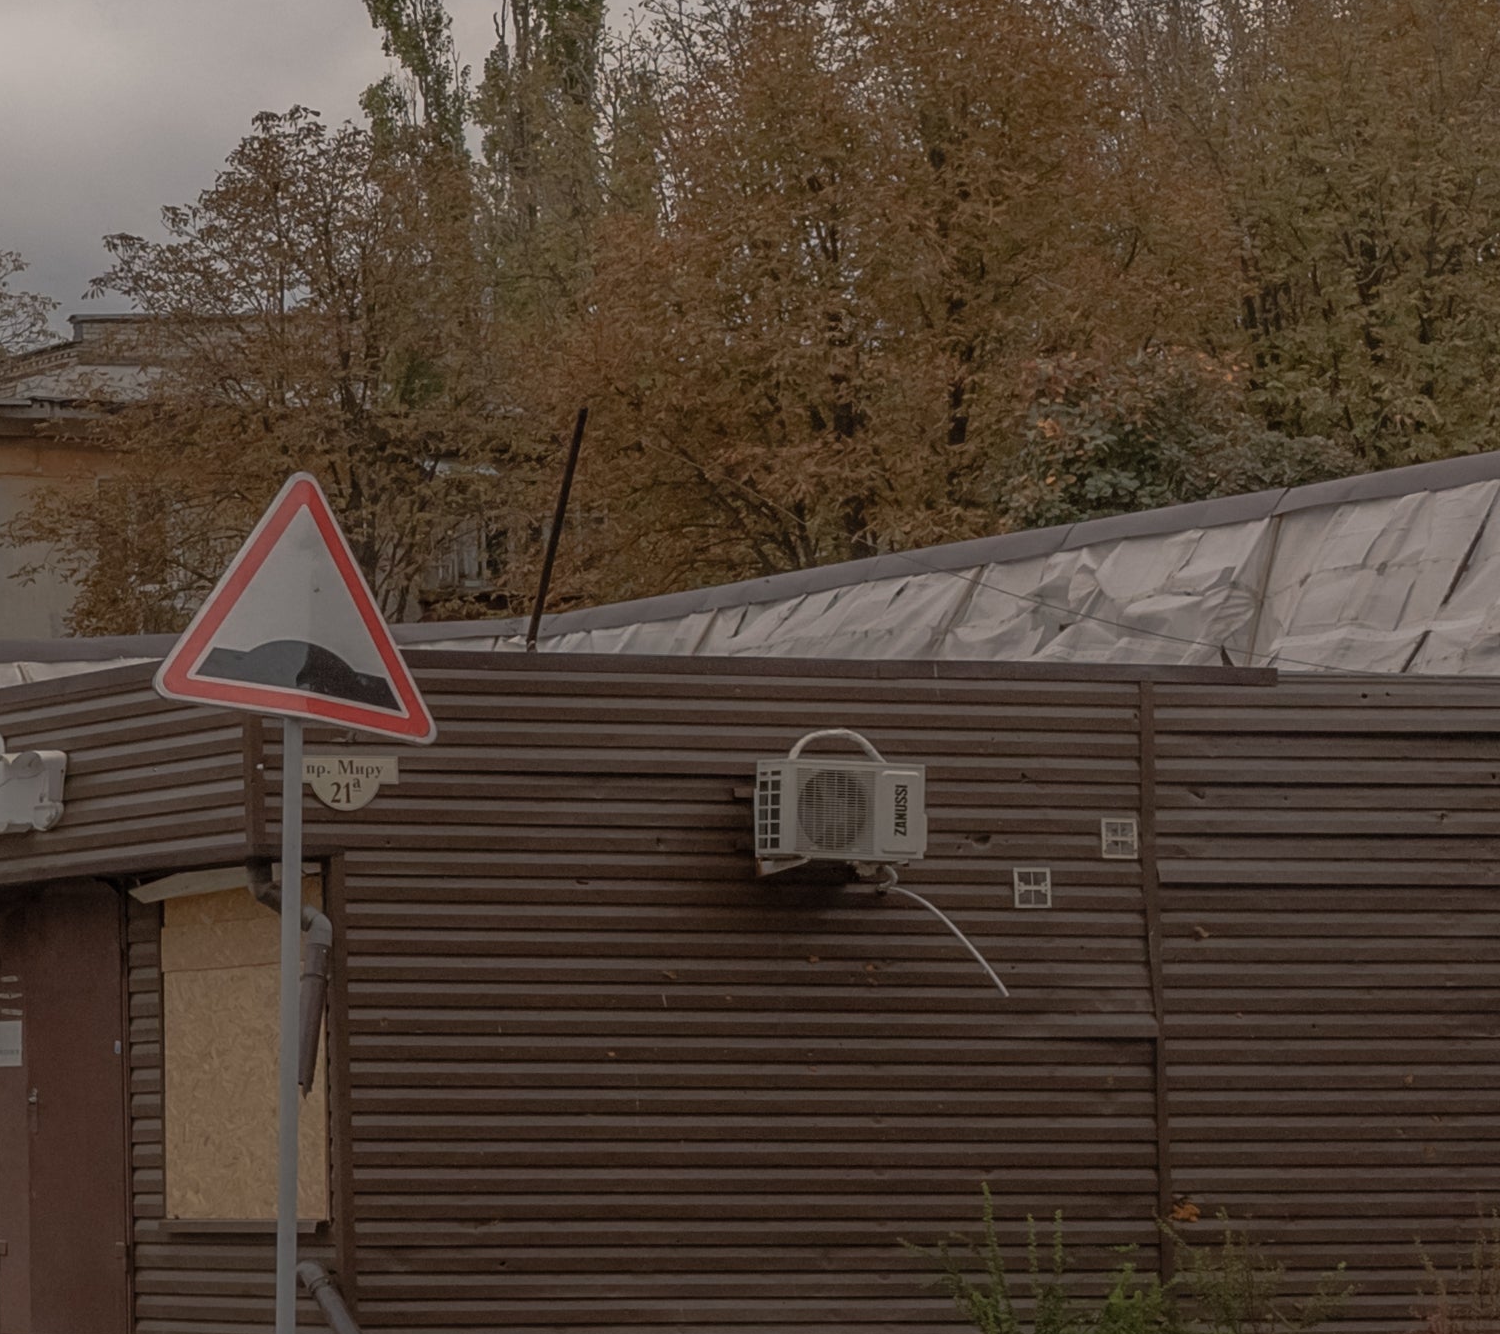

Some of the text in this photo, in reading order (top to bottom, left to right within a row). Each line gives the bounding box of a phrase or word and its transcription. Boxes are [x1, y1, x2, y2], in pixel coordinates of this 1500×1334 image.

[306, 759, 384, 779] пр. Миру
[894, 785, 908, 837] ZANUSSI
